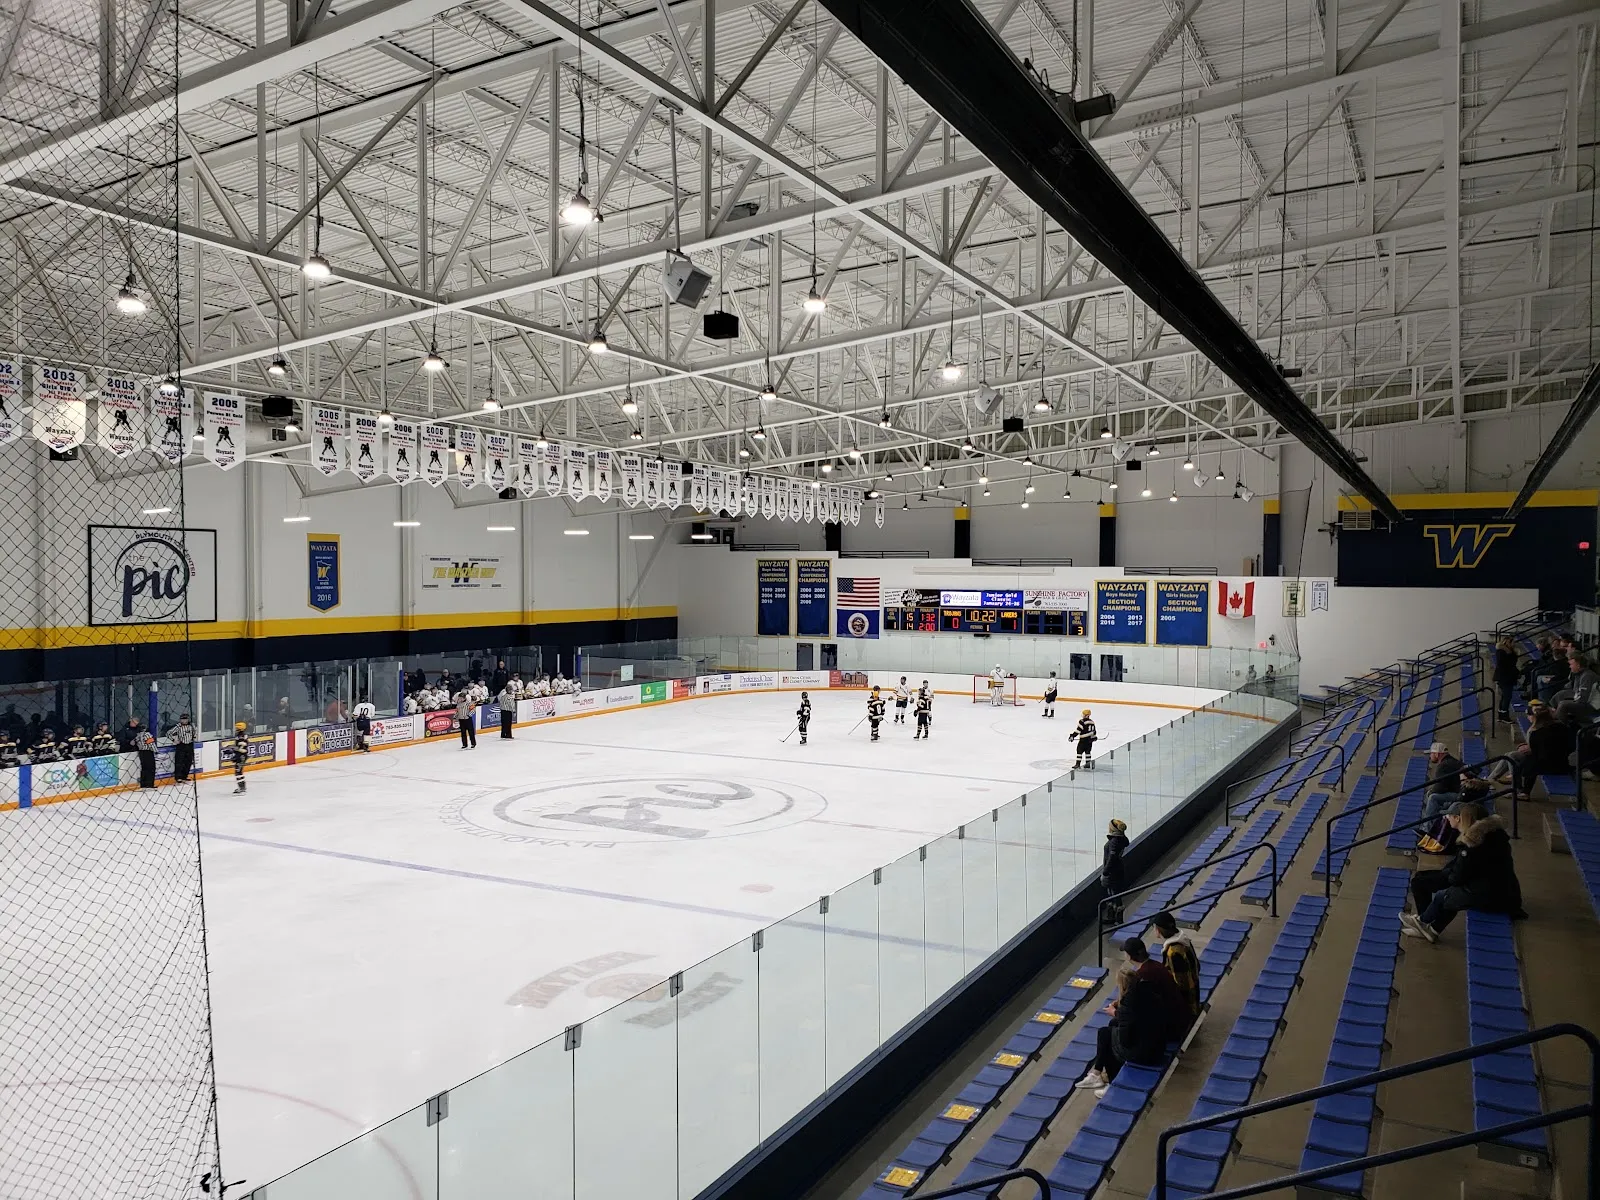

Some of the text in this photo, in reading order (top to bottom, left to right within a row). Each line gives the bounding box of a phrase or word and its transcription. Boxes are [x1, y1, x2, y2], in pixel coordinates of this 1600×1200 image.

[43, 368, 75, 381] 2003
[107, 378, 135, 390] 2003
[212, 397, 238, 408] 2005
[318, 410, 339, 420] 2005
[356, 418, 377, 428] 2006
[394, 423, 412, 433] 2006
[45, 426, 76, 435] Wayzata
[426, 426, 444, 436] 2006
[460, 431, 476, 440] 2007
[490, 436, 506, 445] 2007
[310, 544, 337, 552] WAYZATA
[1424, 524, 1516, 568] W
[121, 561, 188, 617] pic
[1099, 583, 1145, 592] WAYZATA
[1159, 584, 1207, 592] WAYZATA
[317, 593, 332, 602] 2016
[1058, 590, 1088, 598] FACTORY
[906, 612, 936, 622] 15 1:32
[970, 610, 995, 622] 10:22
[906, 622, 936, 631] 14 2:00
[952, 617, 959, 629] 0
[1077, 626, 1084, 636] 3
[324, 729, 352, 739] WAYZAT
[258, 743, 275, 755] OF
[325, 739, 351, 750] HOCKE
